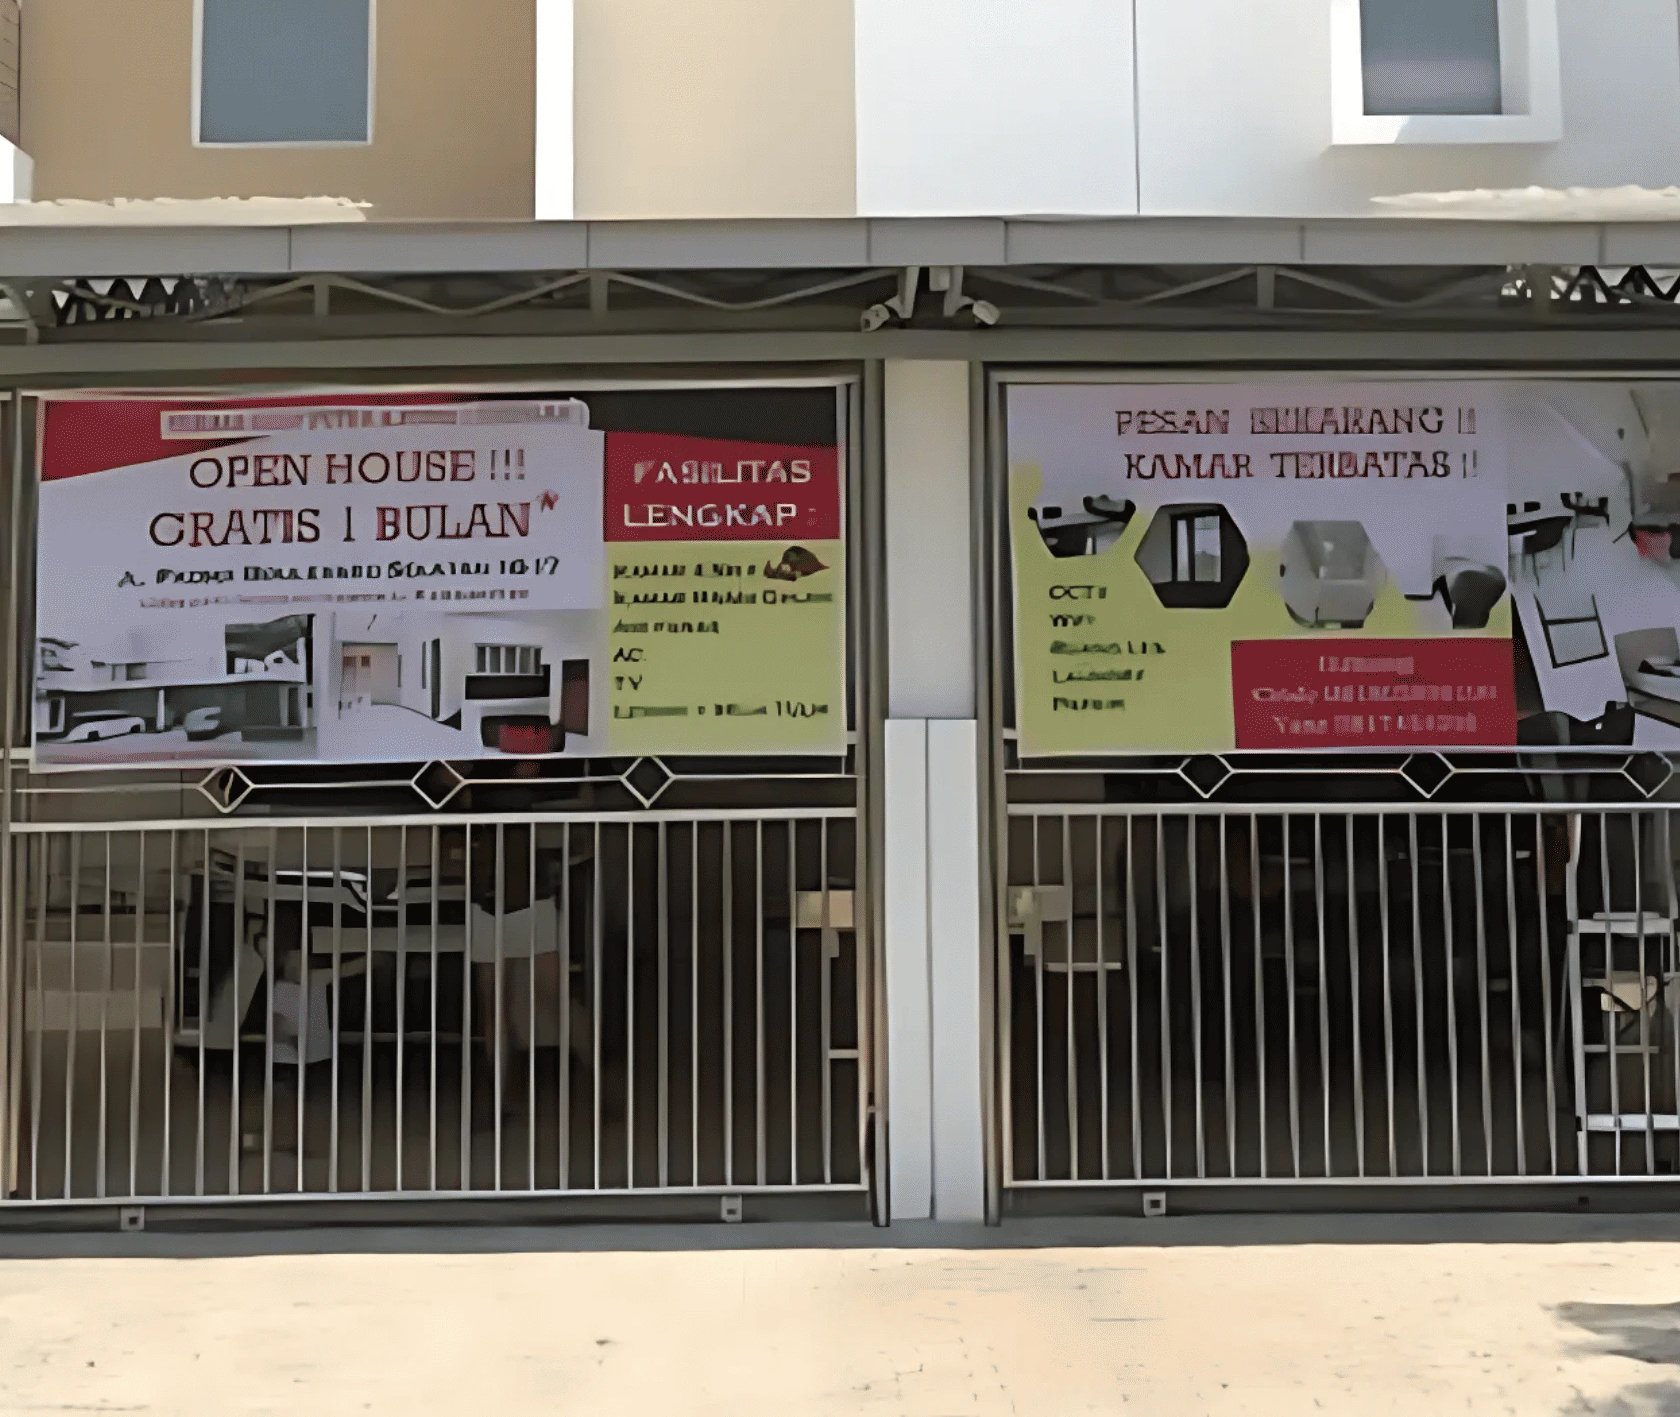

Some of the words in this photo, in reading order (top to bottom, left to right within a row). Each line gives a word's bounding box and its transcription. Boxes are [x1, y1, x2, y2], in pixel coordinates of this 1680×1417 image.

[189, 454, 311, 488] OPEN
[325, 450, 475, 484] HOUSE
[149, 509, 320, 546] GRATIS
